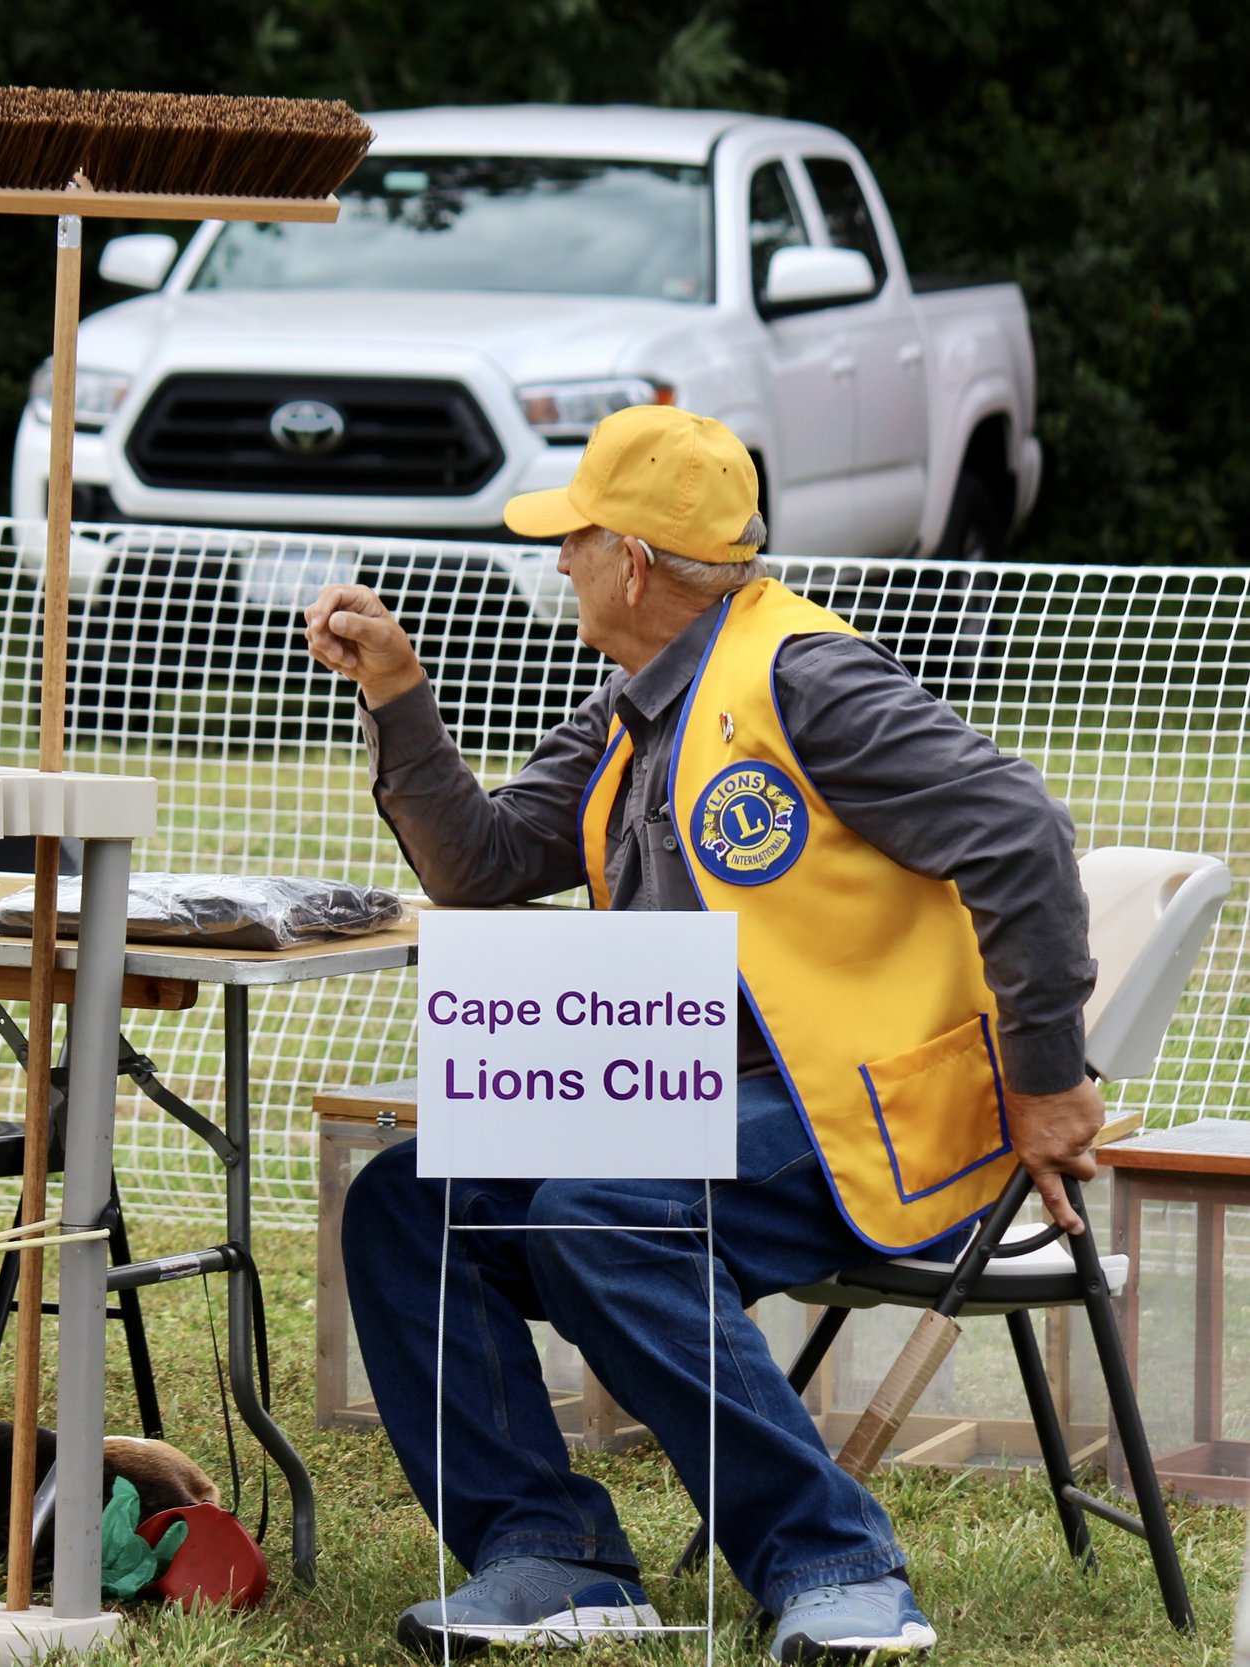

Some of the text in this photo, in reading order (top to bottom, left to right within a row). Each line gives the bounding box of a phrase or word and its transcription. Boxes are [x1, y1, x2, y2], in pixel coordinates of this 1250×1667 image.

[709, 774, 761, 807] LIONS
[730, 802, 765, 840] L
[731, 836, 786, 866] INTERNATIONAL
[428, 990, 726, 1034] Cape Charles
[445, 1058, 723, 1101] Lions Club
